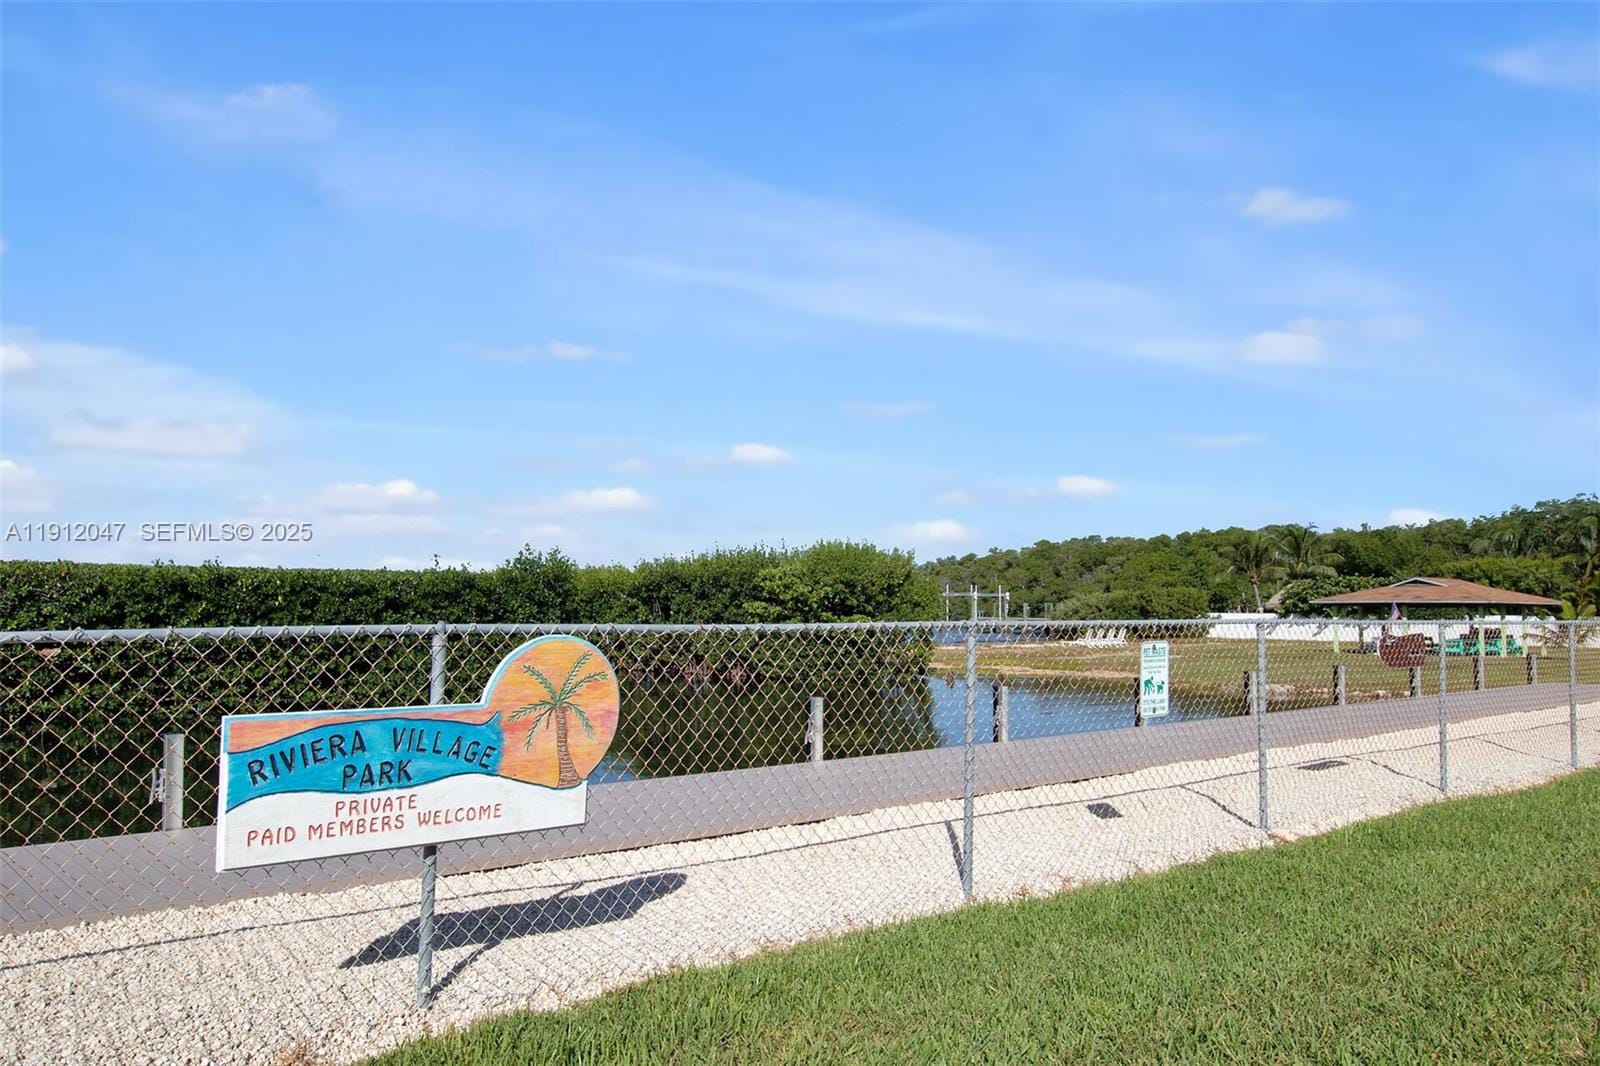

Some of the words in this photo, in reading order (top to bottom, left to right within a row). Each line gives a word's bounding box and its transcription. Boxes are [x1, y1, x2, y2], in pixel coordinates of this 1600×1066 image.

[247, 730, 366, 787] RIVIERA
[393, 727, 498, 770] VILLAGE
[342, 759, 413, 790] PARK
[335, 794, 418, 818] PRIVATE
[247, 826, 297, 848] PAID
[308, 814, 405, 841] MEMBERS
[418, 803, 503, 826] WELCOME
